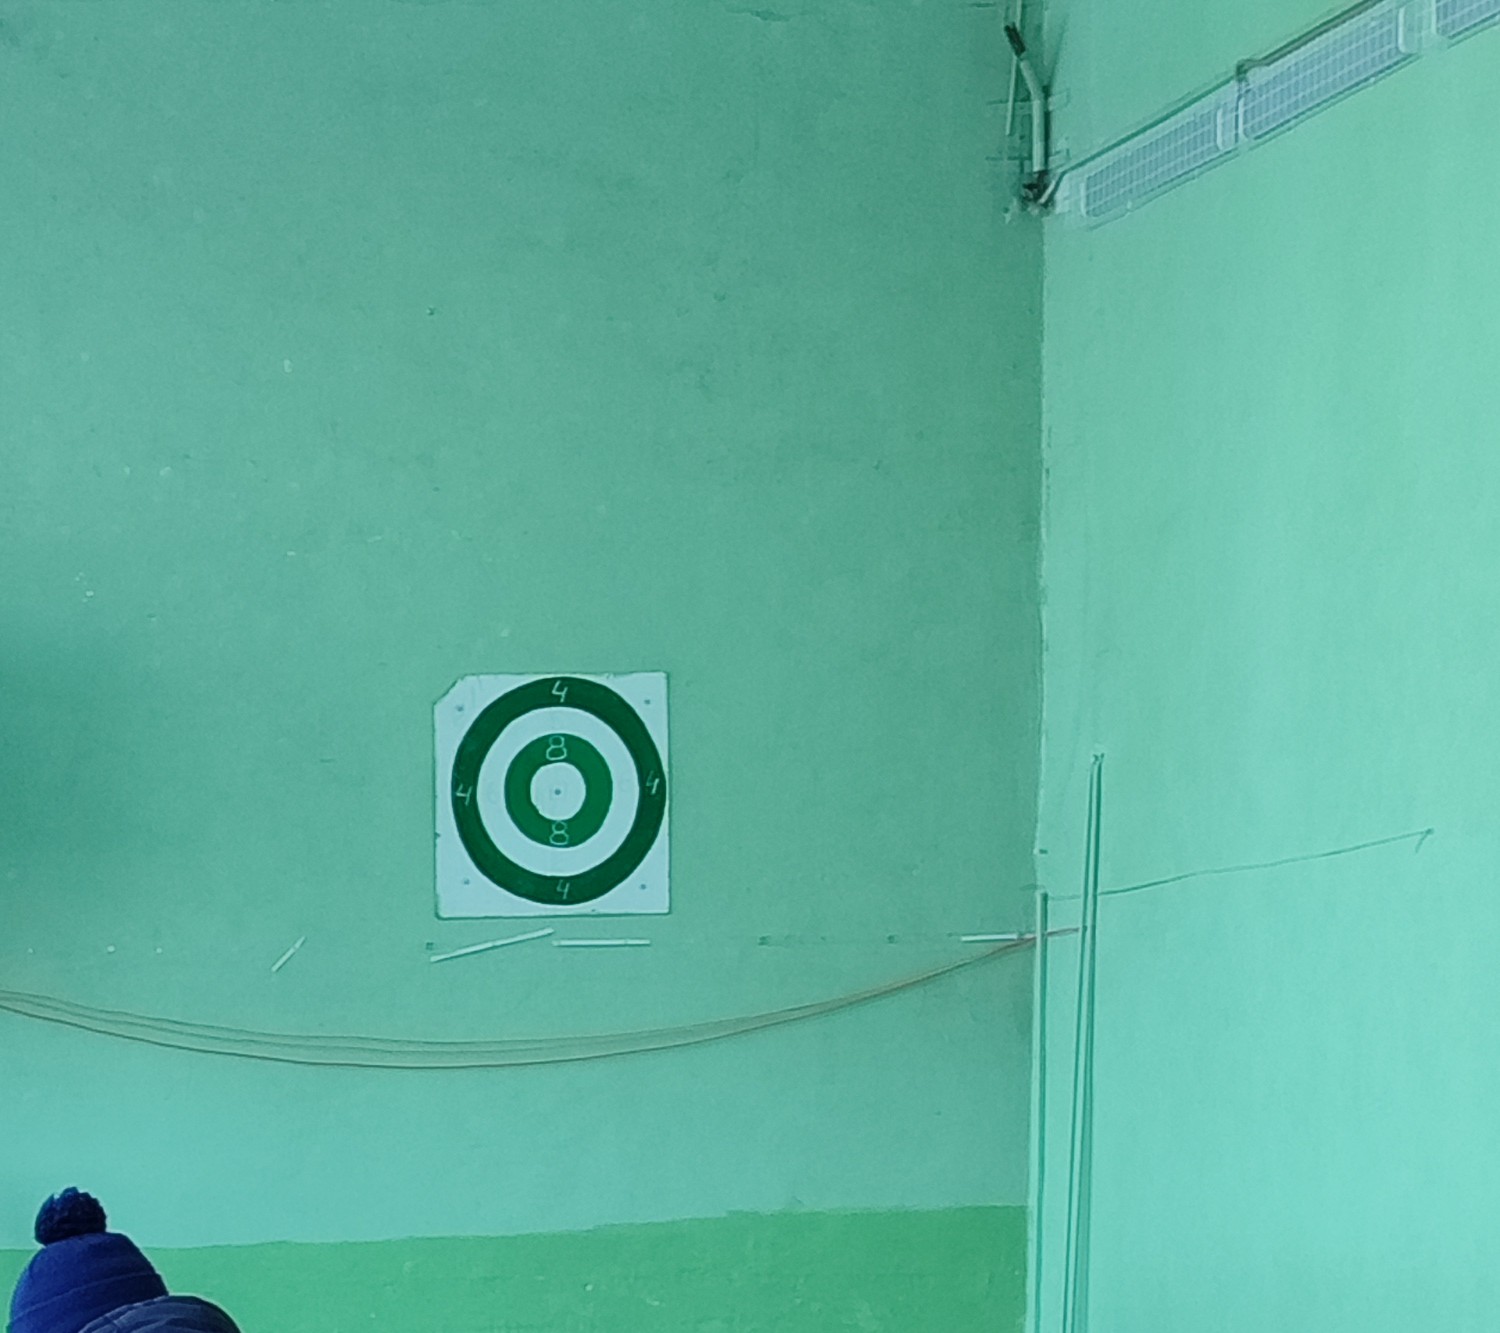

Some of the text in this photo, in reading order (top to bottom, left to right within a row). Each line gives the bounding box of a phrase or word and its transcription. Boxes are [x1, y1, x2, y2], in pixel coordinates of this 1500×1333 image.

[551, 680, 569, 703] 4
[545, 735, 568, 761] 8
[456, 783, 473, 806] 4
[645, 771, 660, 795] 4
[549, 820, 570, 846] 8
[556, 879, 571, 900] 4
